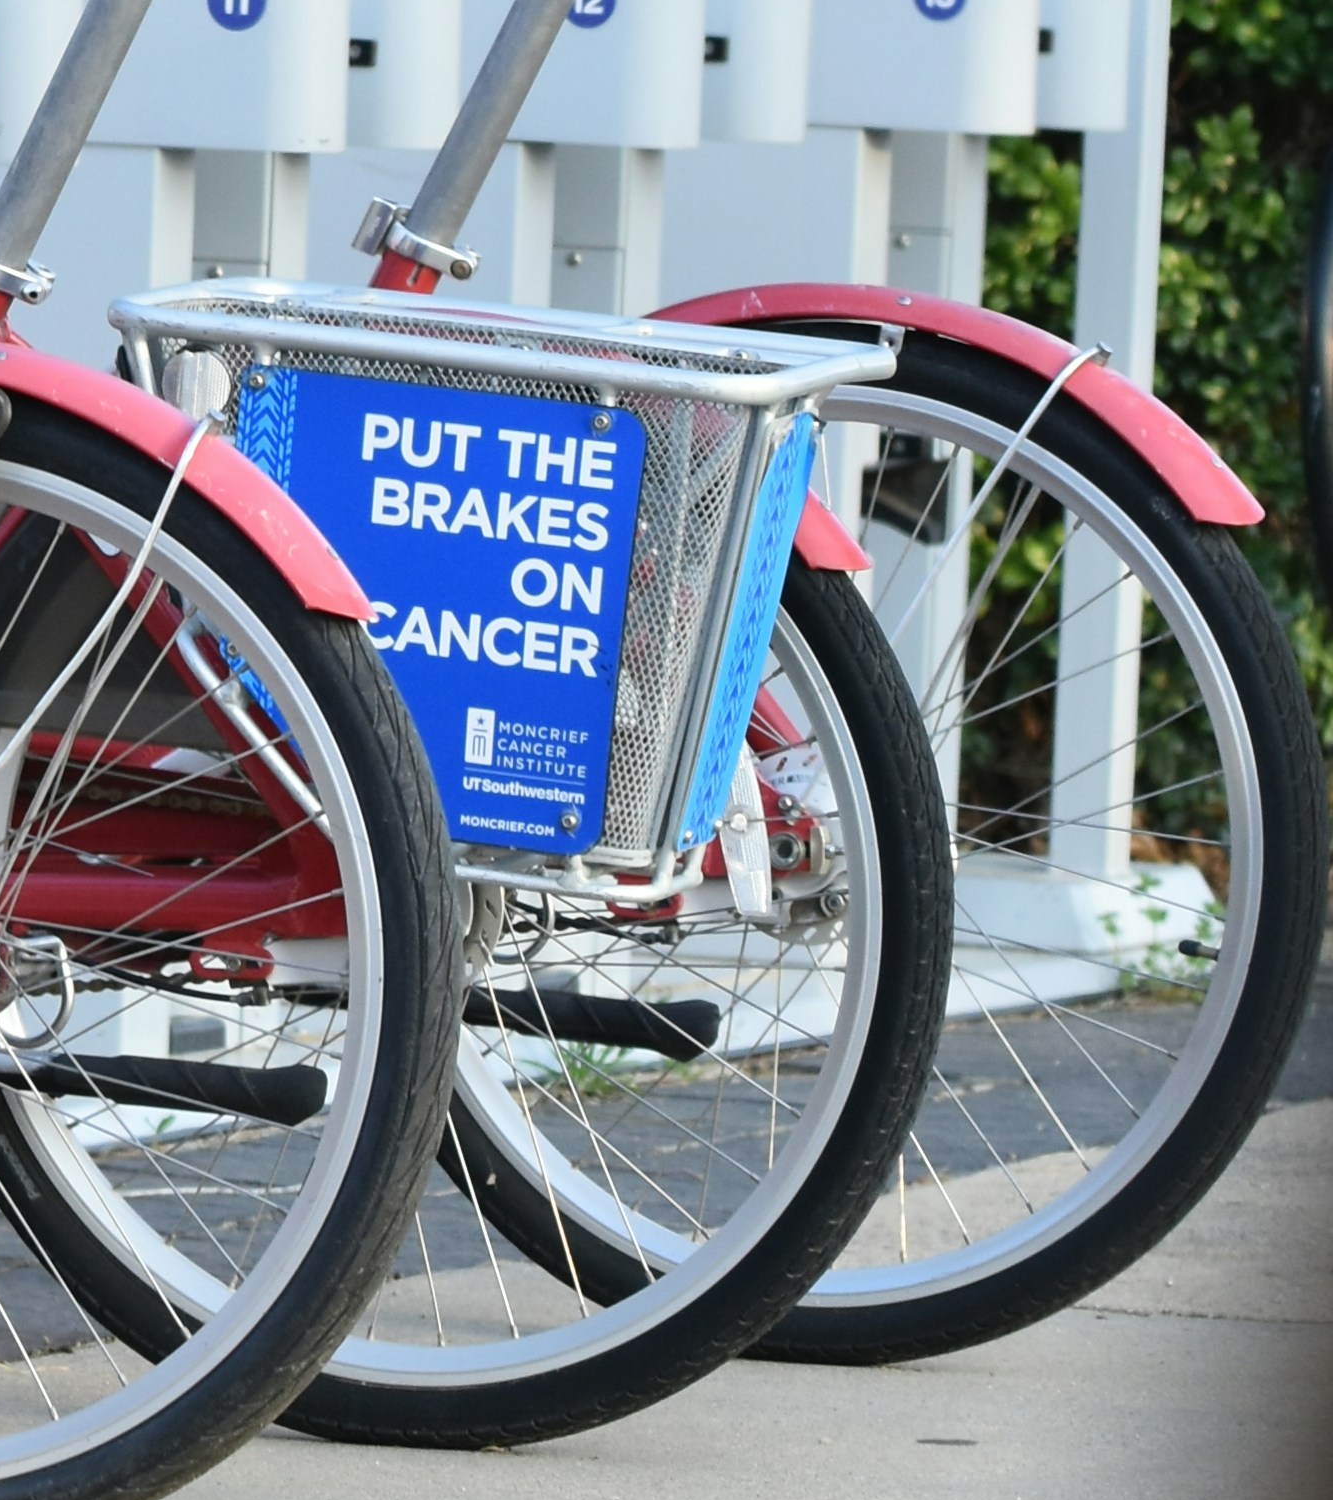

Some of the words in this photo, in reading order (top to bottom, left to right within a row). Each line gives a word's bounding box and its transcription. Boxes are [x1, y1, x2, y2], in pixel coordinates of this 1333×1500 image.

[362, 412, 482, 472] PUT
[498, 428, 617, 490] THE
[371, 476, 610, 551] BRAKES
[510, 557, 603, 615] ON
[361, 600, 598, 678] CANCER
[497, 738, 567, 759] CANCER
[498, 720, 589, 744] MONCRIEF
[496, 755, 587, 779] INSTITUTE
[460, 814, 555, 838] MONCRIEF.COM
